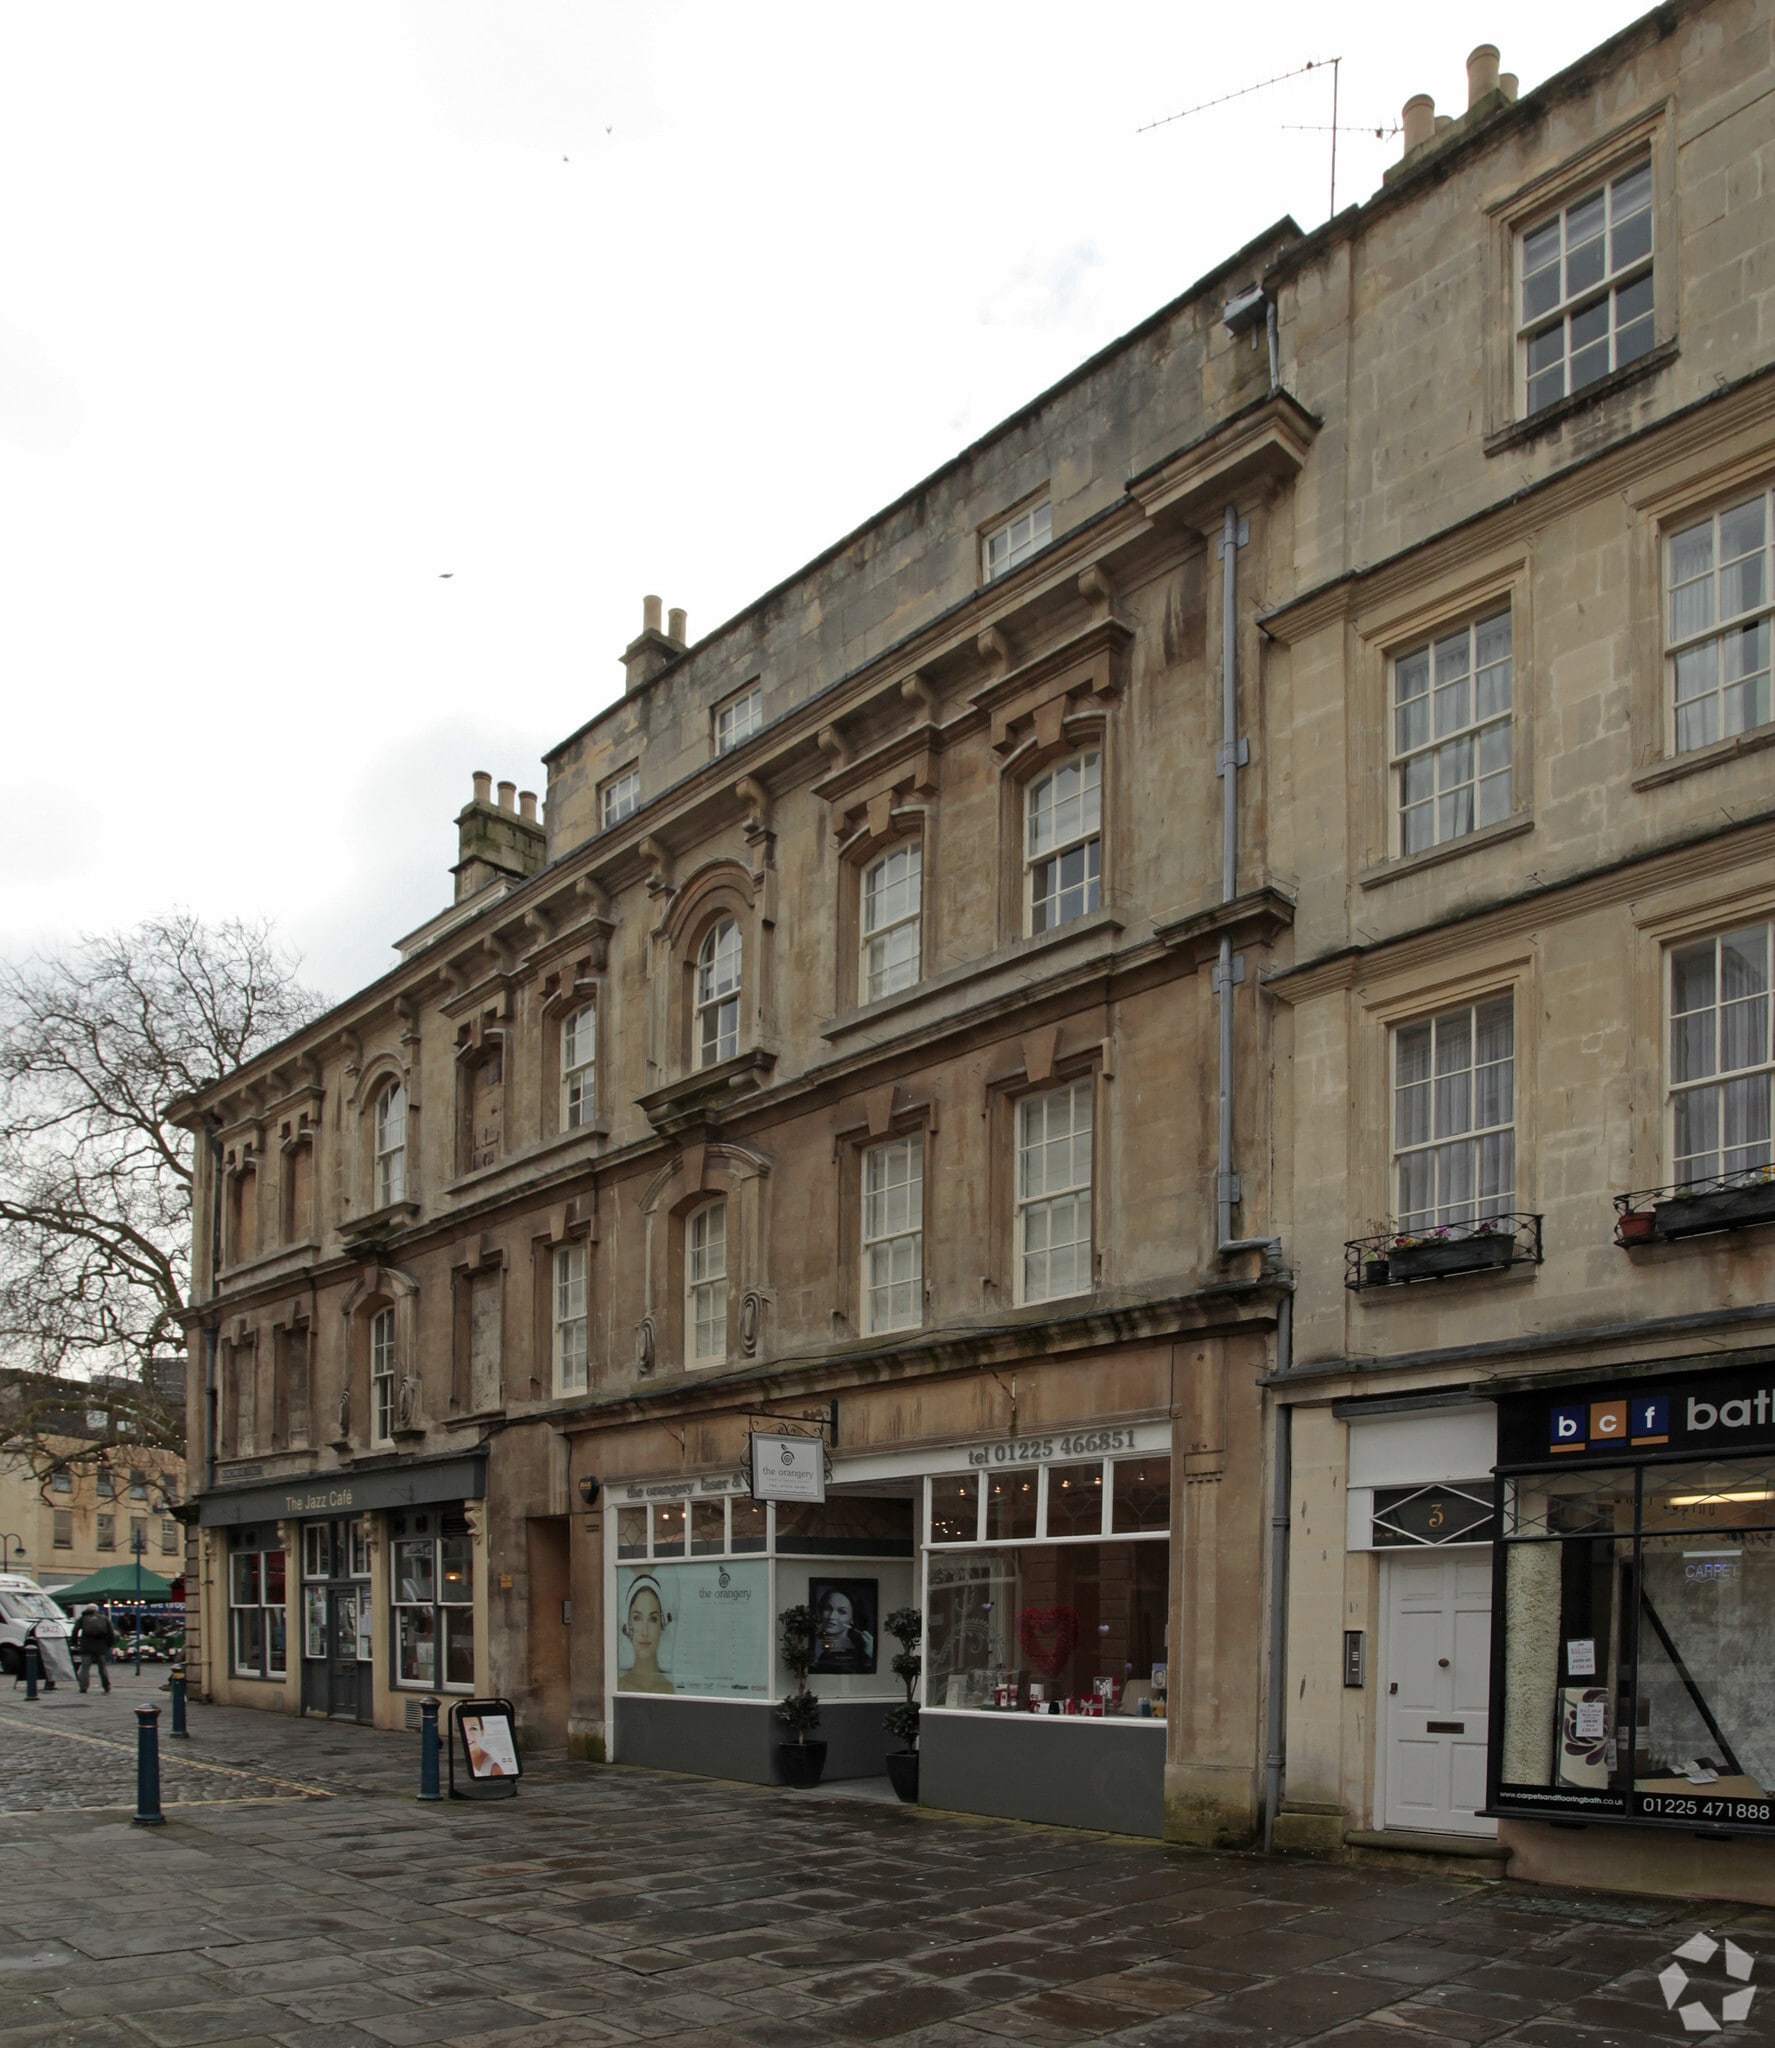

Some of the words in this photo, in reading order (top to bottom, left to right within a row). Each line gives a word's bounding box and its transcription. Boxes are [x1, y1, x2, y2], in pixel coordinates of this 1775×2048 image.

[1686, 1388, 1775, 1431] bat
[968, 1446, 989, 1465] tel
[994, 1438, 1054, 1463] 01225
[1060, 1428, 1136, 1456] 466851
[763, 1466, 776, 1477] the
[778, 1468, 814, 1481] orangery
[626, 1484, 644, 1499] the
[646, 1482, 695, 1497] orangery
[701, 1477, 730, 1491] laser
[285, 1496, 303, 1512] The
[305, 1494, 327, 1510] Jazz
[329, 1488, 353, 1507] Café
[1428, 1503, 1444, 1528] 3
[1684, 1563, 1739, 1579] CARPET
[699, 1586, 712, 1599] the
[714, 1589, 752, 1601] orangery
[1500, 1791, 1624, 1806] www.carpetsandflooringbath.co.uk
[1643, 1797, 1698, 1815] 01225
[1702, 1802, 1770, 1820] 471888
